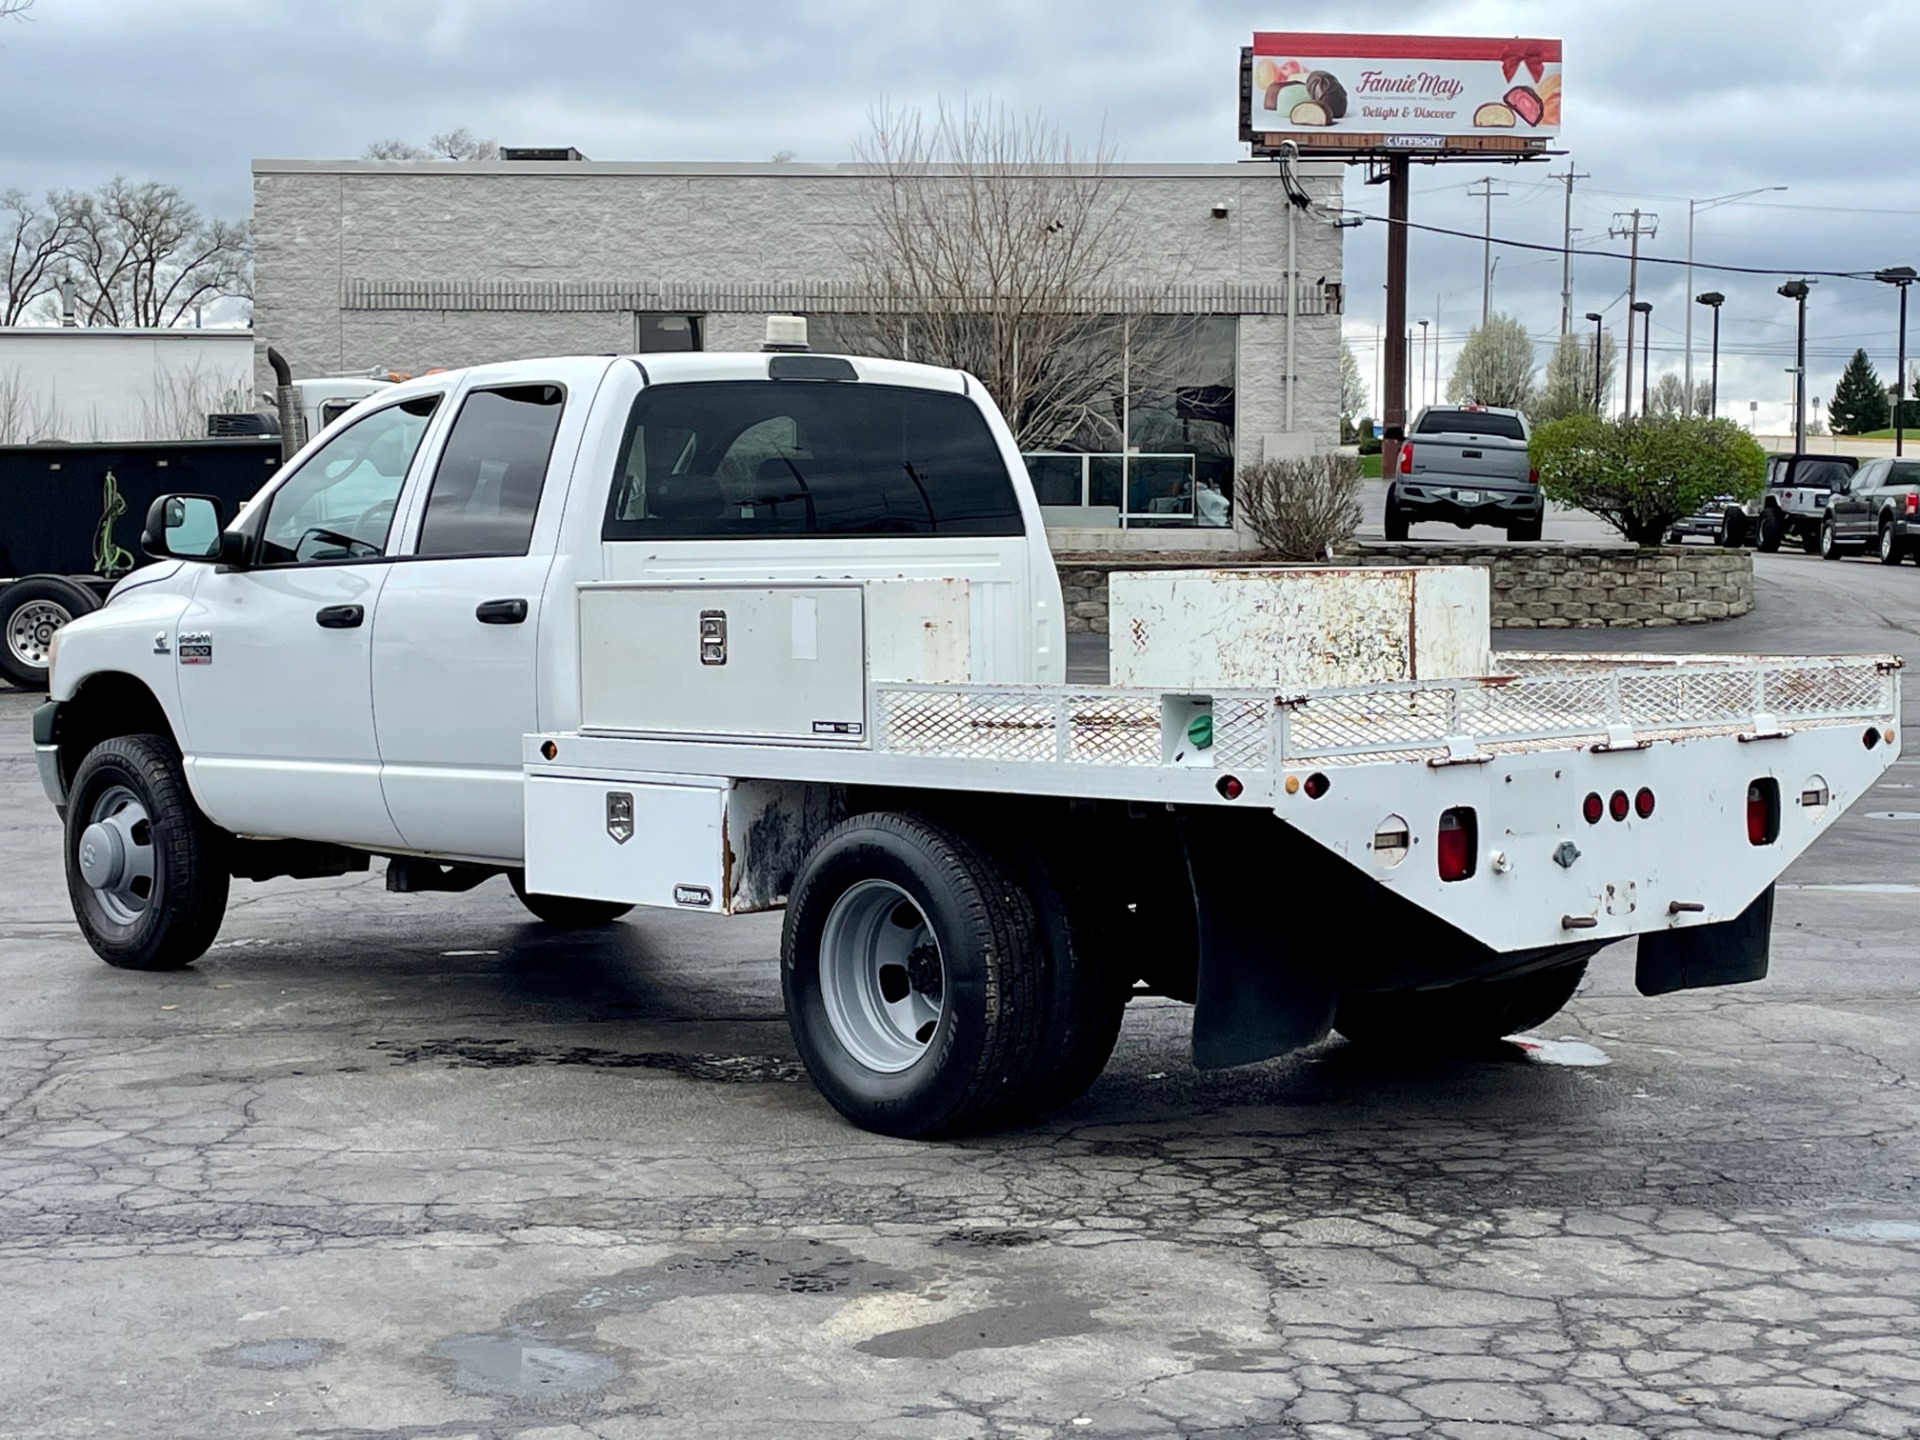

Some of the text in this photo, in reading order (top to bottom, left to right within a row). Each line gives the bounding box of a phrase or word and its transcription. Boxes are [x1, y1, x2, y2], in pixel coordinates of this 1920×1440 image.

[1356, 71, 1464, 100] Fannie May
[1362, 106, 1457, 120] Delight & Discover
